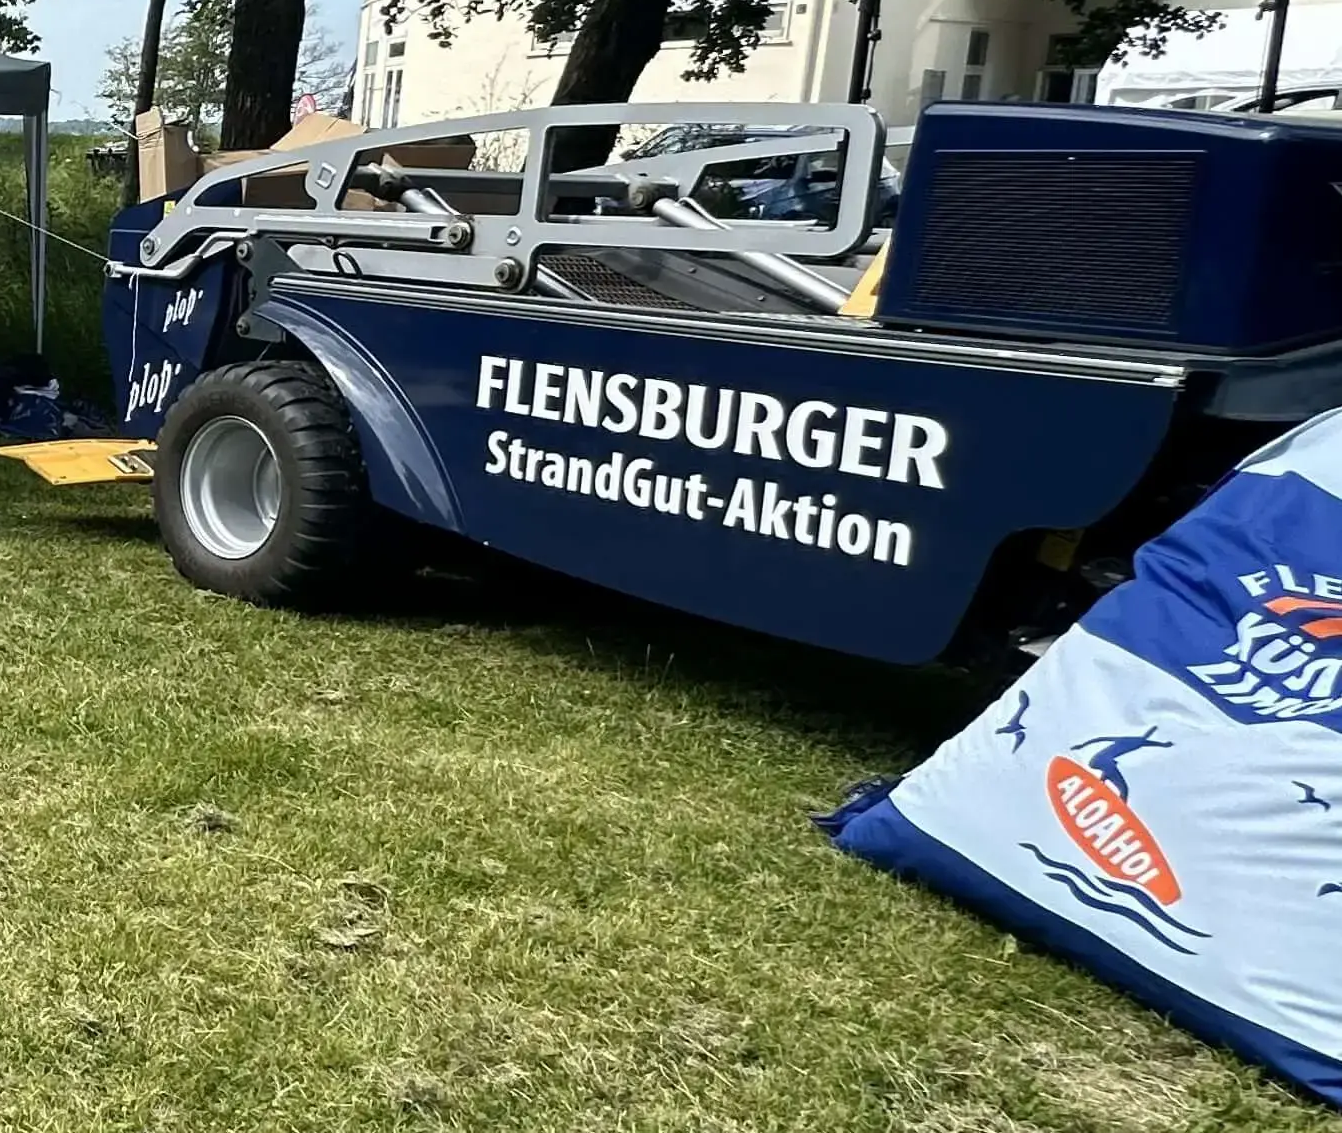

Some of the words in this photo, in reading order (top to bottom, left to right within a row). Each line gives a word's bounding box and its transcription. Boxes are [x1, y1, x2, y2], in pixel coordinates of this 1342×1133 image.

[475, 354, 951, 490] FLENSBURGER
[484, 429, 915, 567] StrandGut-Aktion
[1056, 774, 1161, 885] ALOAHOI
